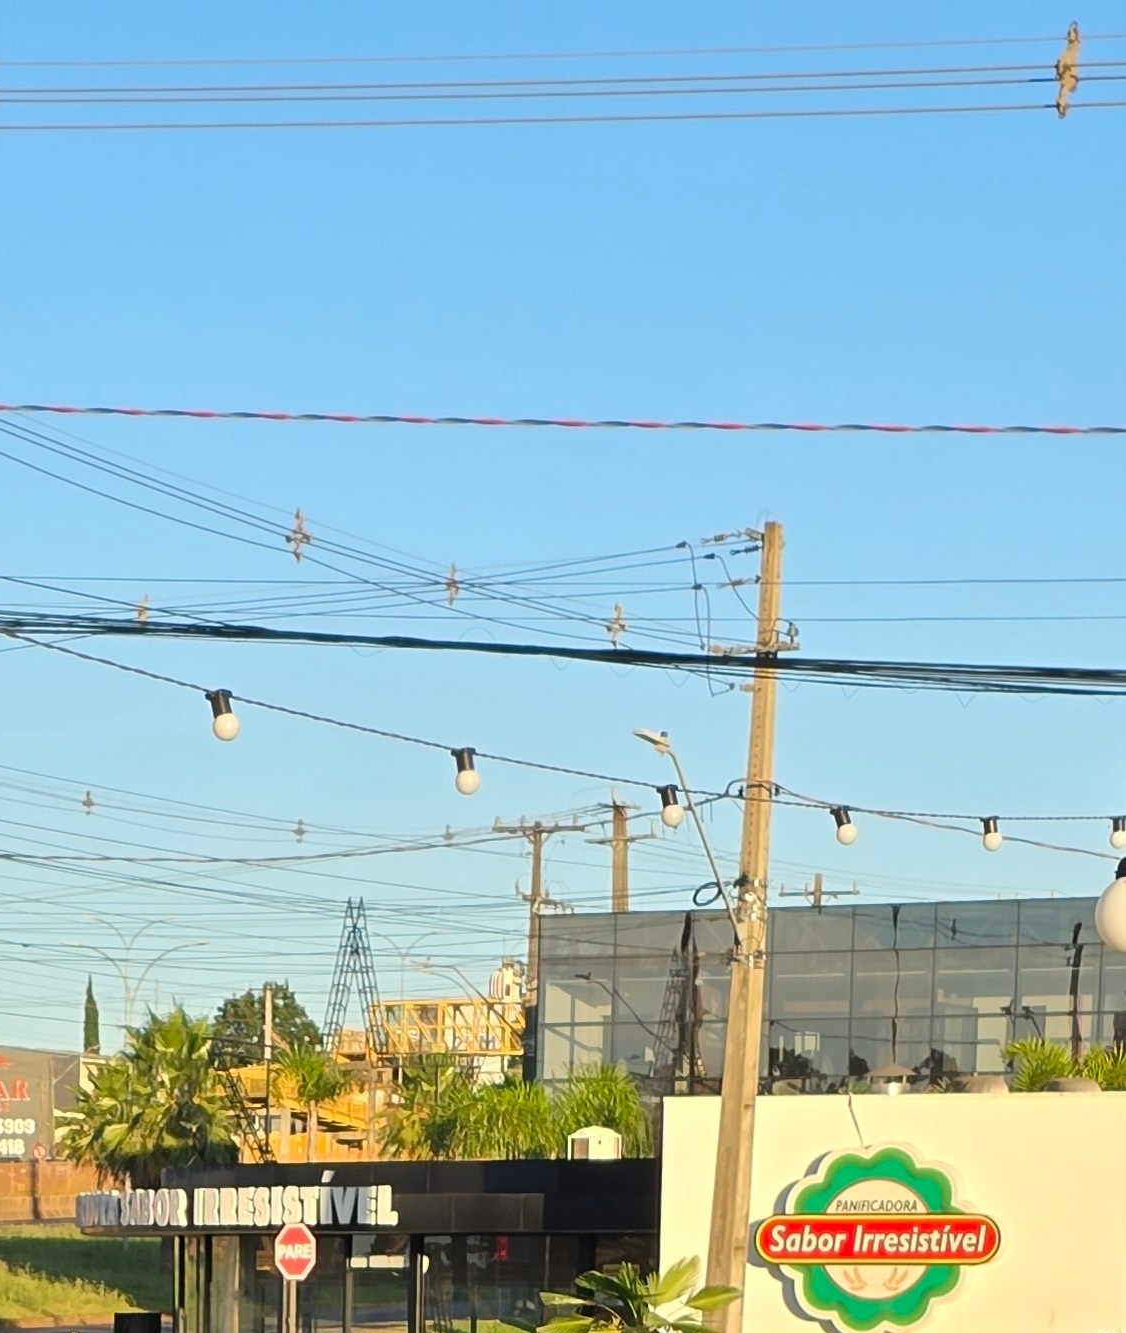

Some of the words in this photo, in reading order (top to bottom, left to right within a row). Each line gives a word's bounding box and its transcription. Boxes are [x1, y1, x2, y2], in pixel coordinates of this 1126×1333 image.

[120, 1187, 188, 1227] SABOR
[193, 1170, 399, 1227] IRRESISTÍVEL
[835, 1199, 919, 1213] PANIFICADORA
[769, 1225, 847, 1252] Sabor
[854, 1224, 986, 1252] Irresistível
[278, 1242, 313, 1261] PARE
